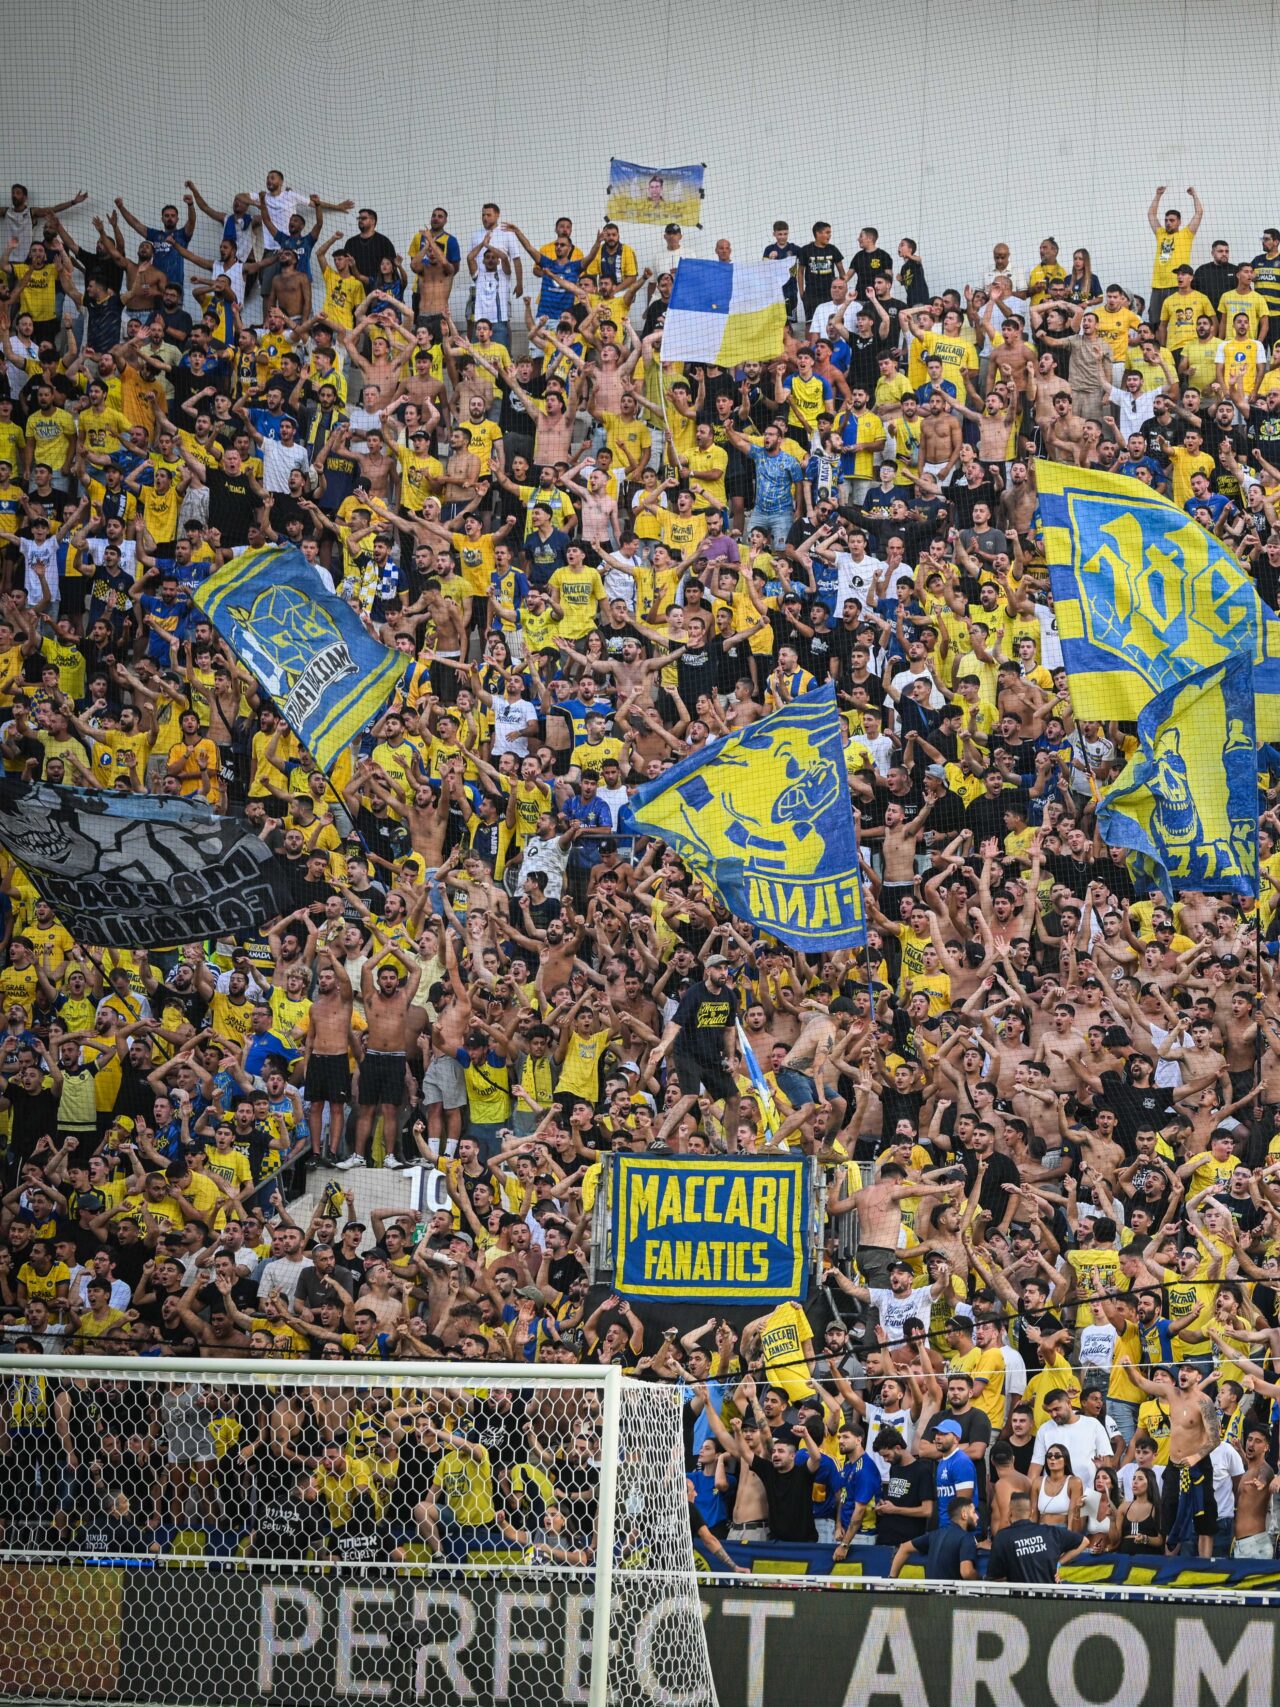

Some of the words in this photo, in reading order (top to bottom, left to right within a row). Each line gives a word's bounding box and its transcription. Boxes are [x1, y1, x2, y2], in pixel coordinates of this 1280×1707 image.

[247, 951, 271, 959] ANADA
[630, 1173, 789, 1247] MACCABI
[643, 1239, 770, 1282] FANATICS
[762, 1327, 795, 1347] MACCABI
[1013, 1535, 1043, 1547] מטאור
[1014, 1544, 1048, 1558] אבטחה
